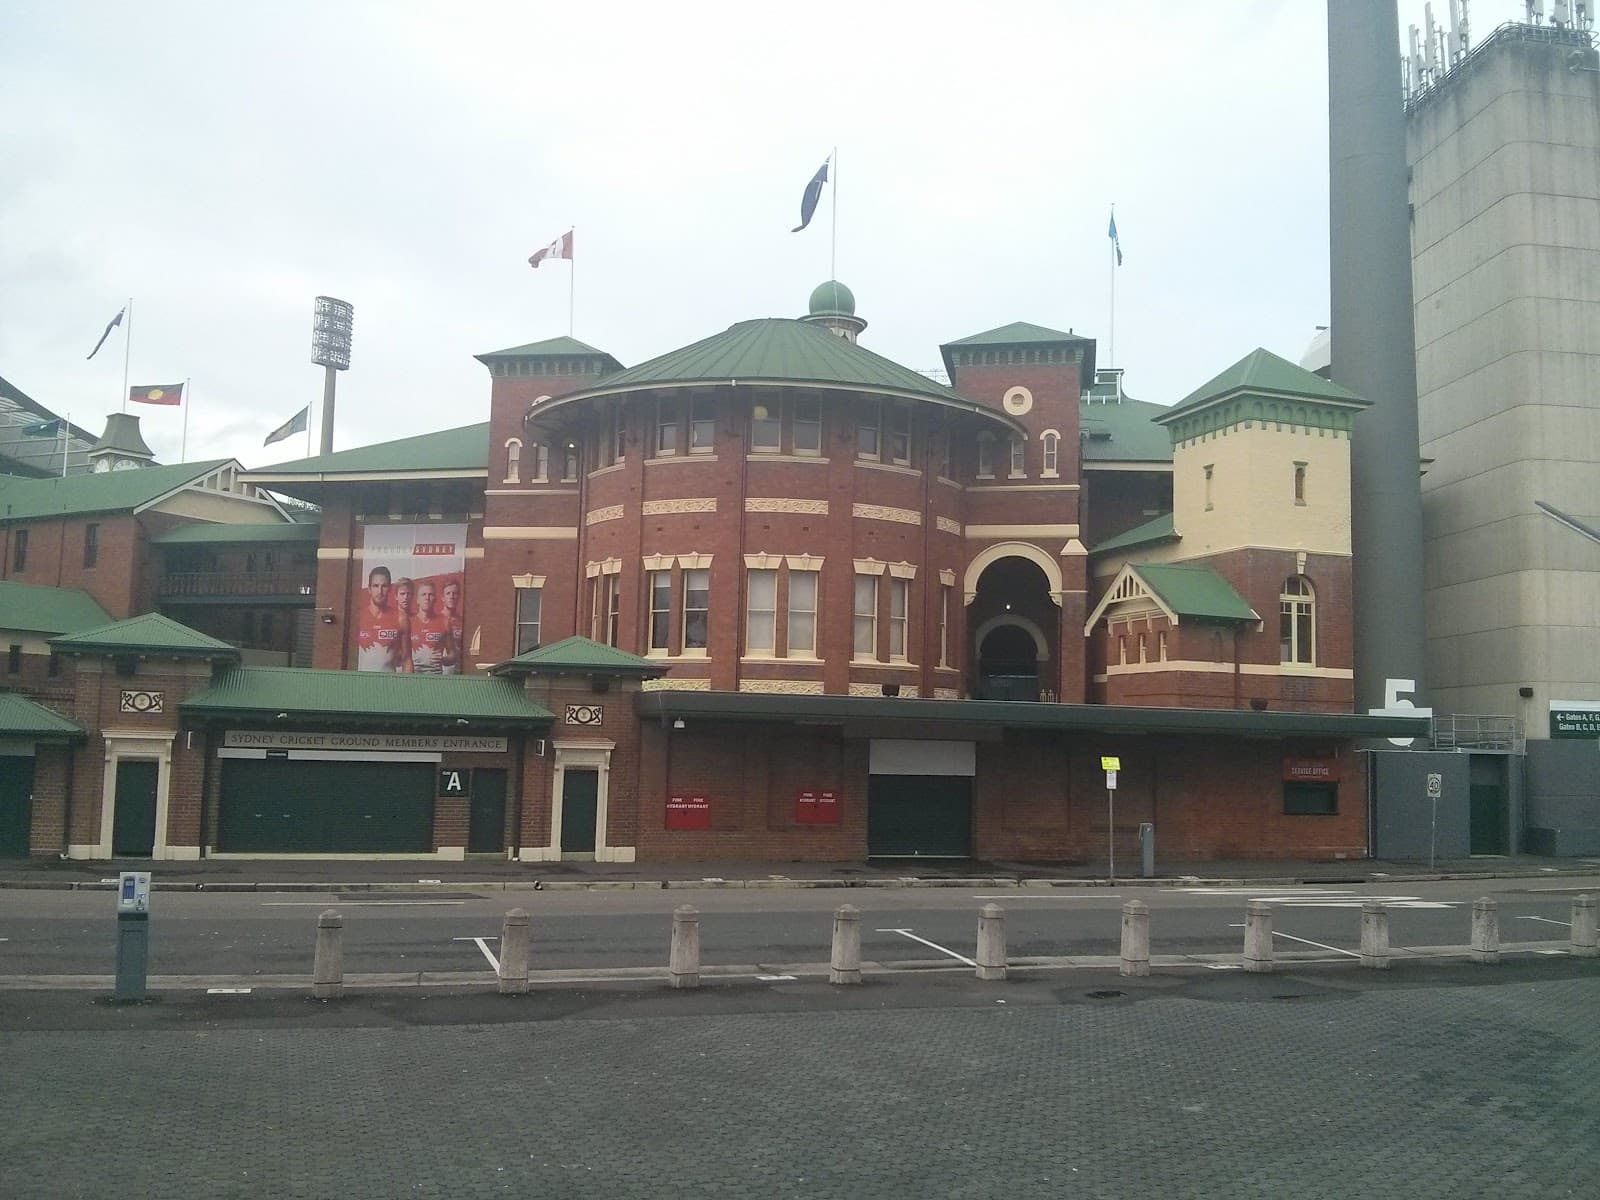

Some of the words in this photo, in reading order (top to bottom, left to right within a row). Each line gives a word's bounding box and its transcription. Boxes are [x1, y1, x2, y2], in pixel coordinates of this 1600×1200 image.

[415, 545, 453, 553] SYDNEY
[1385, 679, 1415, 746] 5
[231, 734, 275, 744] SYDNEY
[280, 735, 325, 745] CRICKET
[331, 737, 380, 747] GROUND
[443, 739, 502, 749] ENTRANCE
[447, 771, 461, 790] A
[1429, 780, 1439, 790] 40
